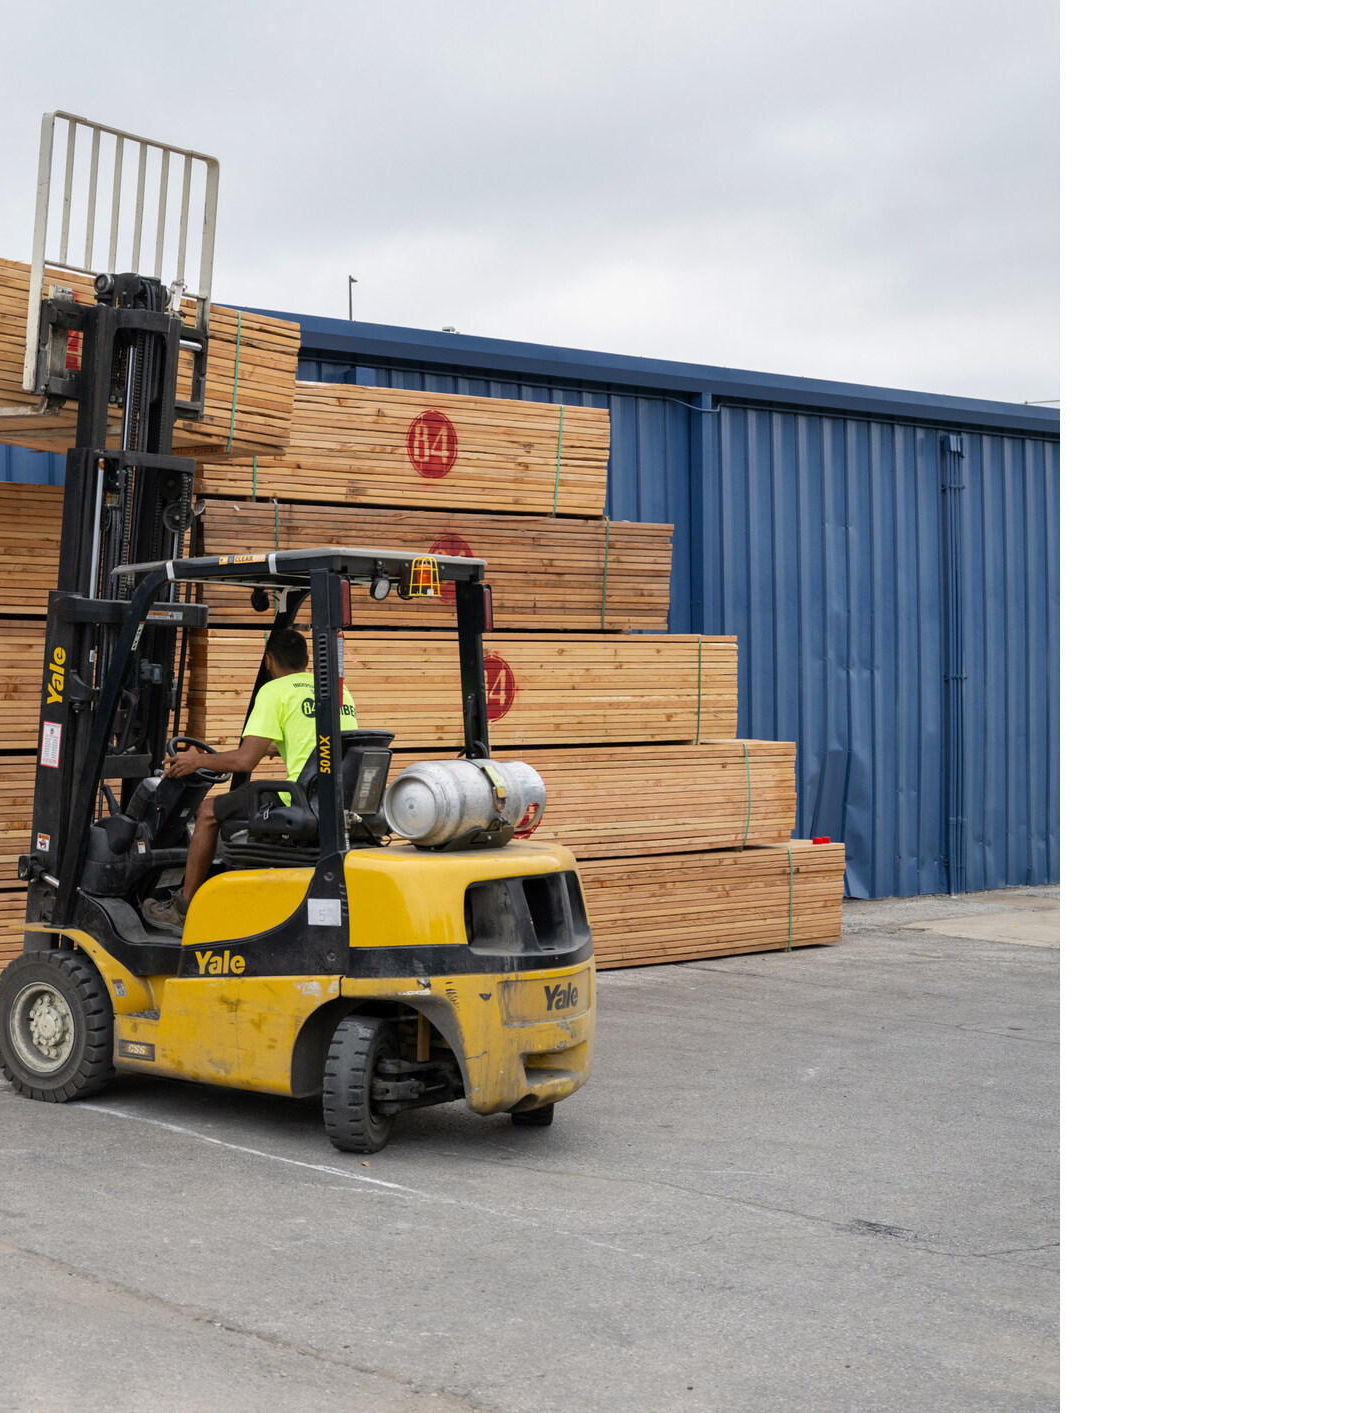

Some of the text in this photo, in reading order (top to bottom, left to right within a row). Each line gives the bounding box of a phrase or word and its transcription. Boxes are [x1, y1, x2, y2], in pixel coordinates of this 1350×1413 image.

[46, 646, 67, 704] Yale
[319, 734, 331, 774] 50MX
[195, 950, 246, 975] Yale
[544, 982, 578, 1011] Yale
[128, 1043, 147, 1054] CSS
